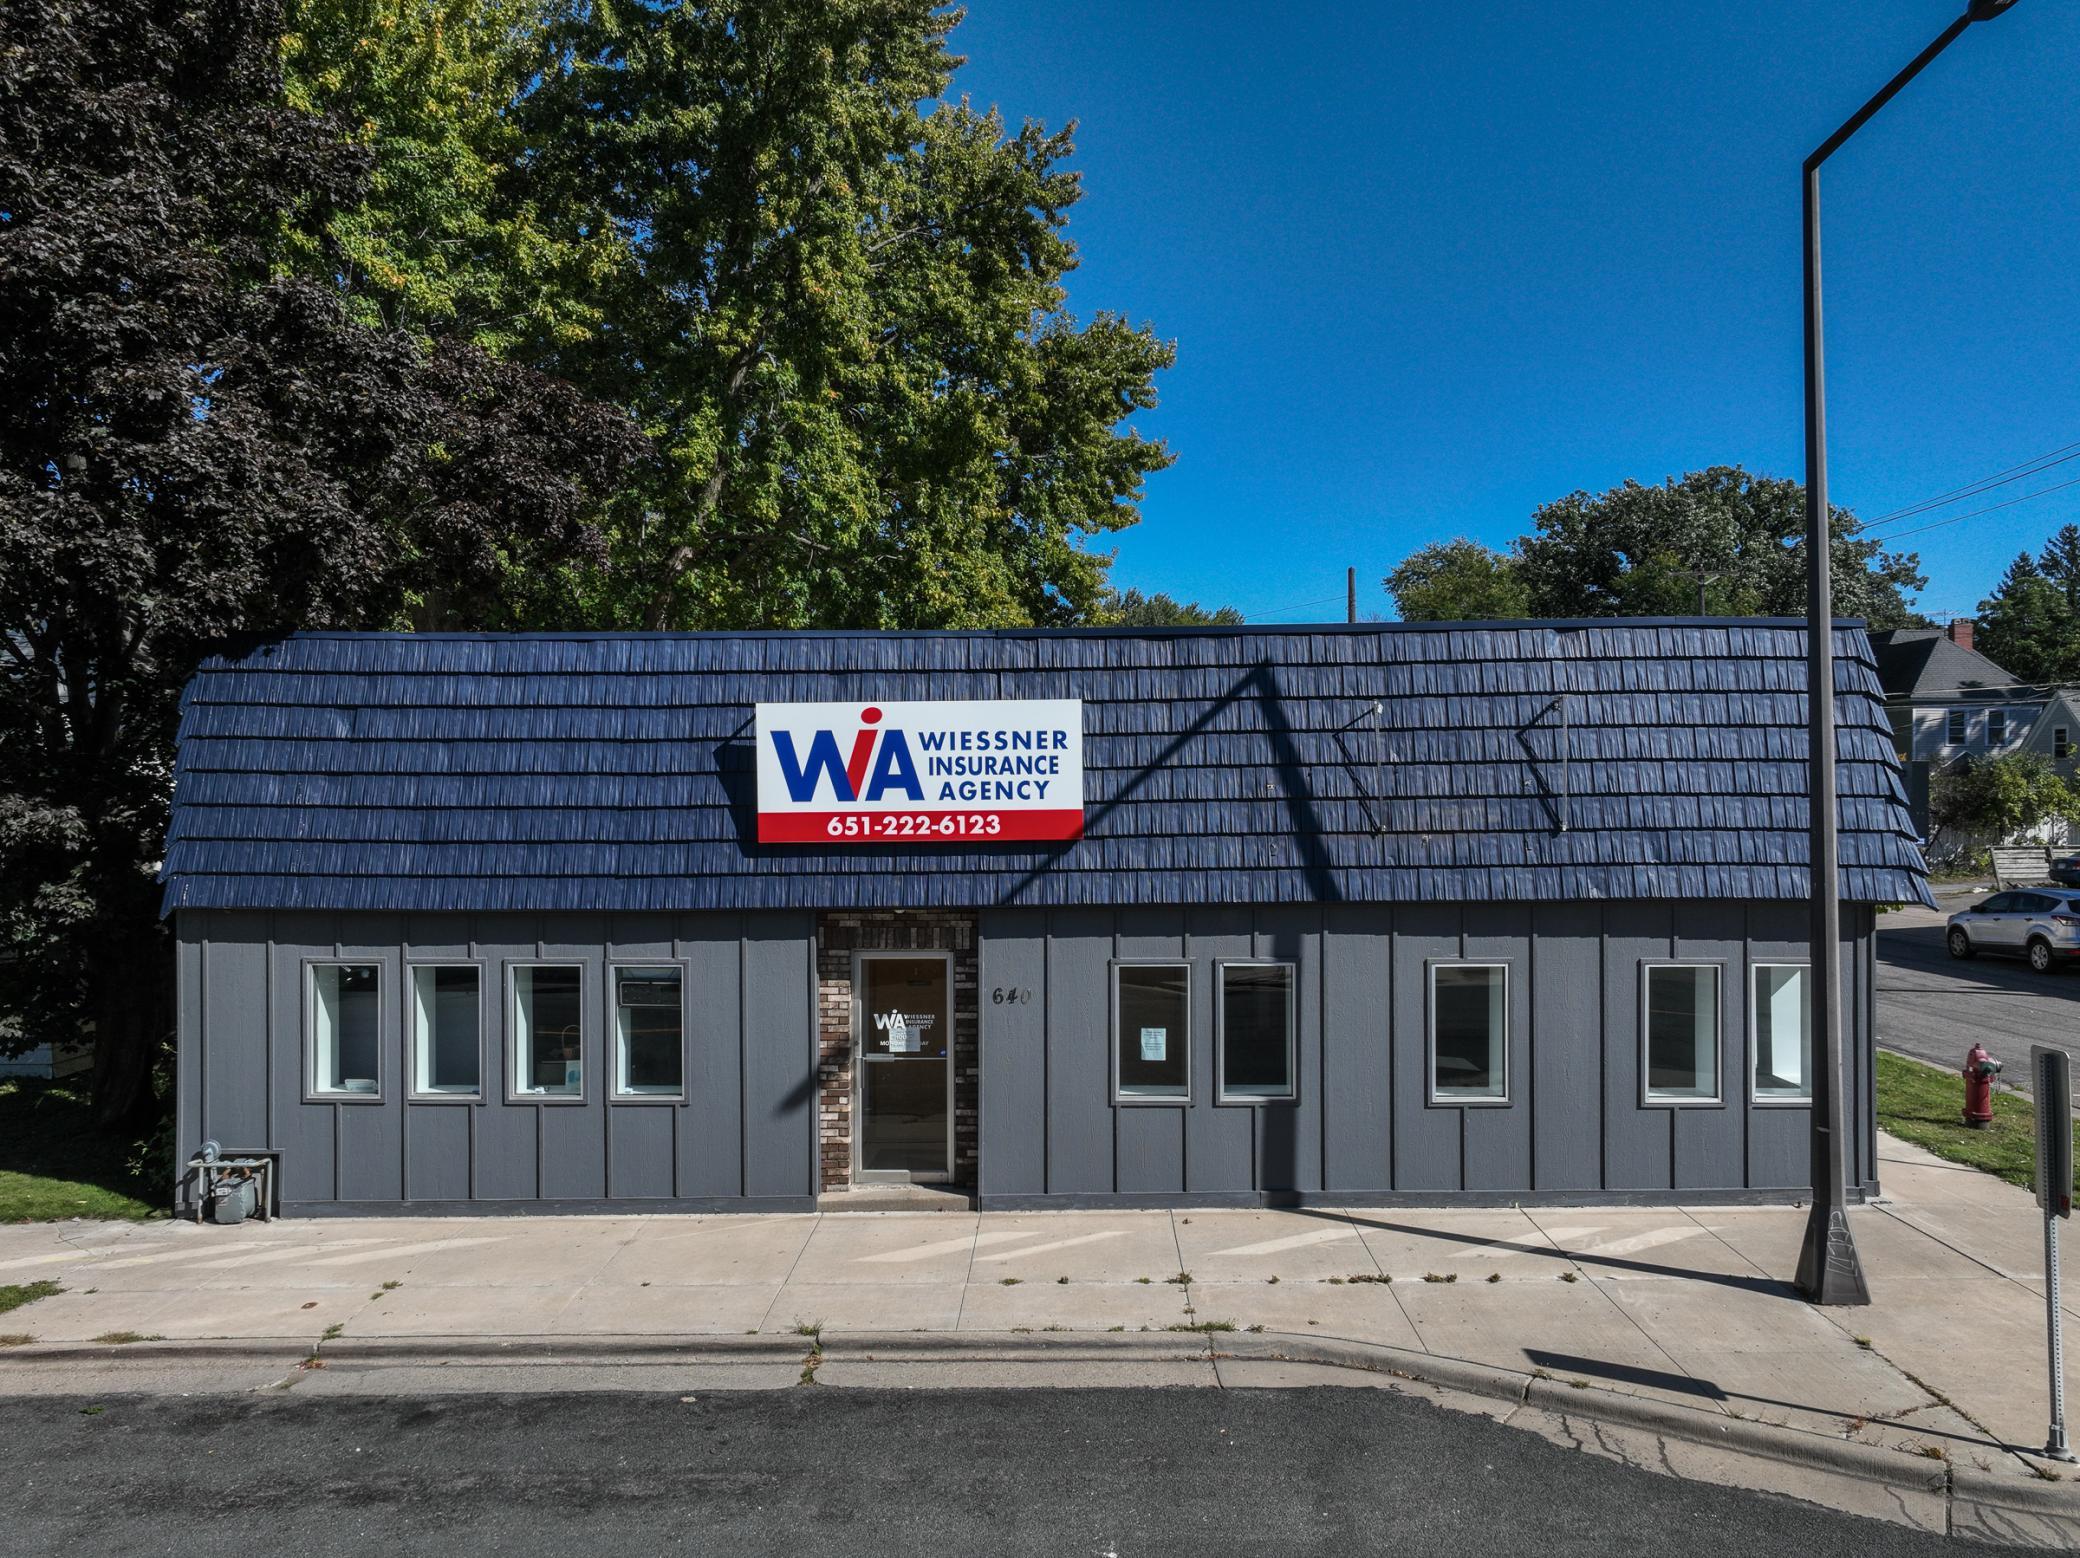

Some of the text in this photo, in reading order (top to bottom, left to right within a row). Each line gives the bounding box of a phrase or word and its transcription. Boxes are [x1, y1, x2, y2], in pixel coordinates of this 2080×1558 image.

[918, 729, 1069, 751] WIESSNER
[928, 755, 1060, 776] INSURANCE
[938, 780, 1050, 801] AGENCY
[826, 814, 1001, 836] 651-222-6123
[992, 987, 1032, 1005] 640
